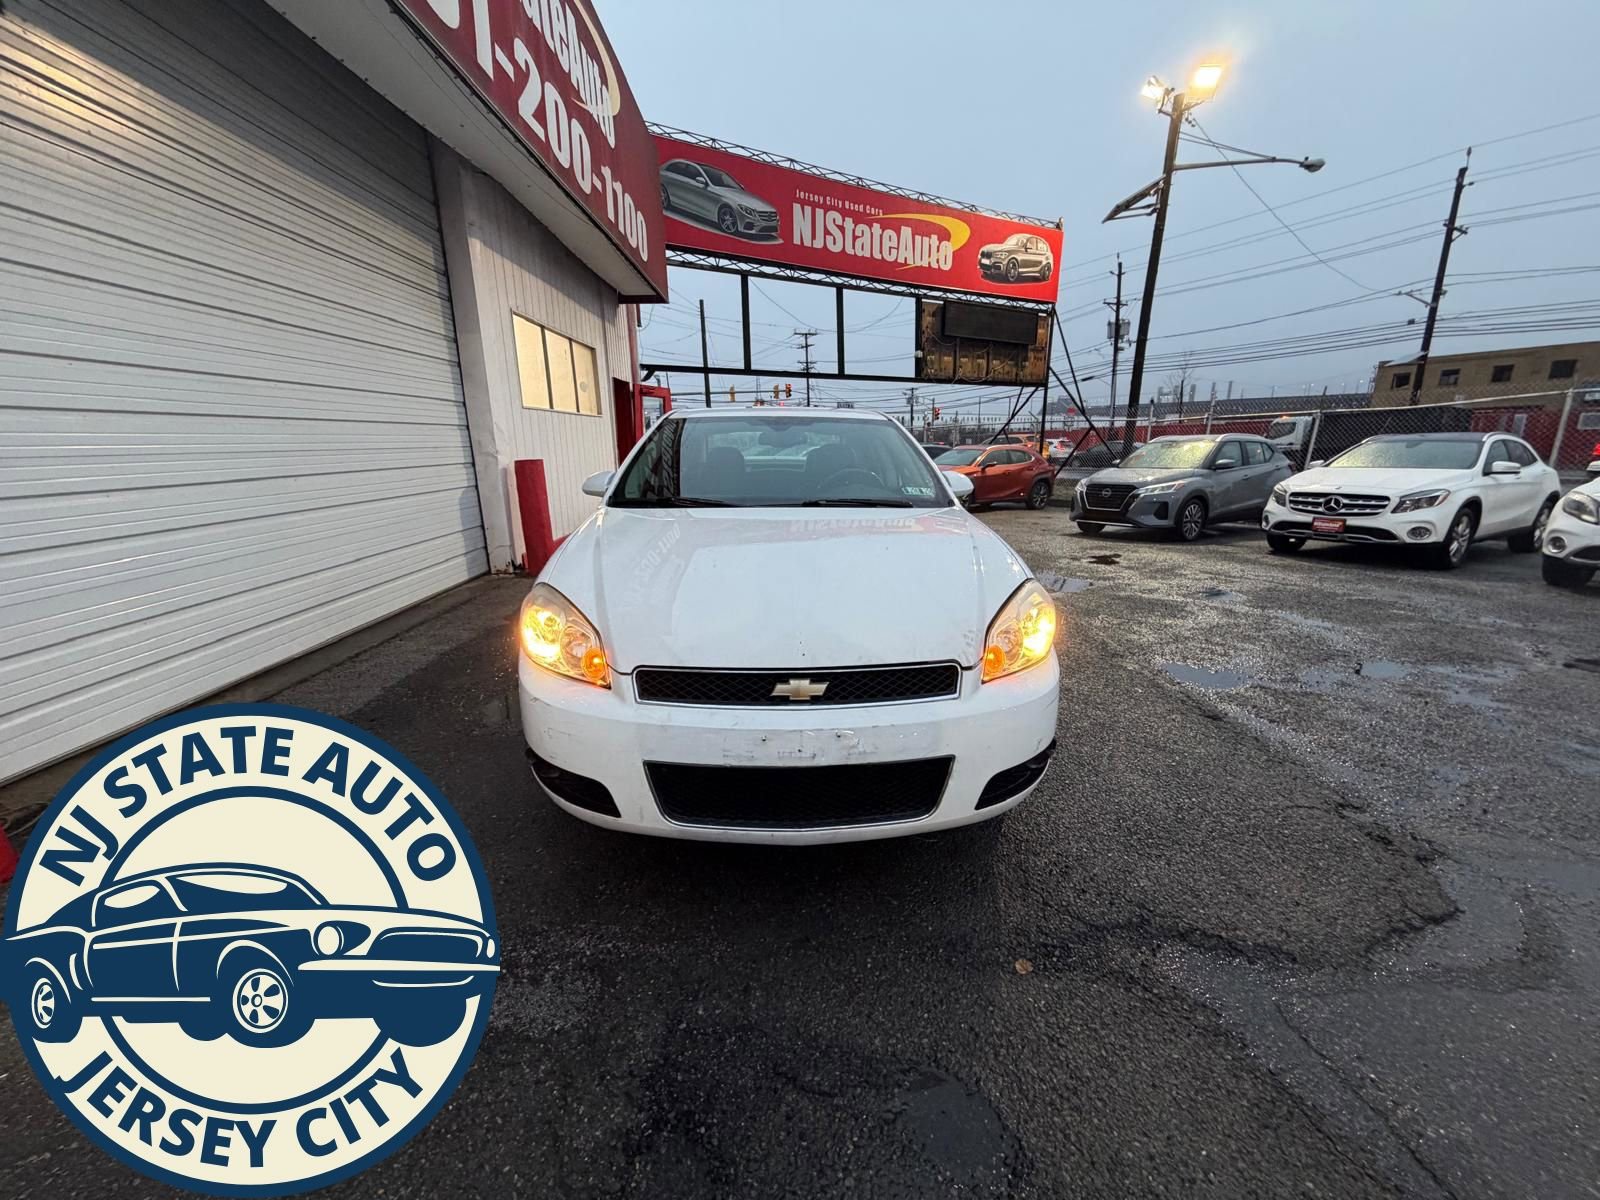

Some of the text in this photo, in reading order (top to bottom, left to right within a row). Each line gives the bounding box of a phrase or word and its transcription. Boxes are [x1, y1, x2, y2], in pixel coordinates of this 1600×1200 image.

[427, 0, 648, 262] 1-200-1100
[792, 202, 953, 271] NJStateAuto
[796, 188, 884, 216] Jersey City Used Cars
